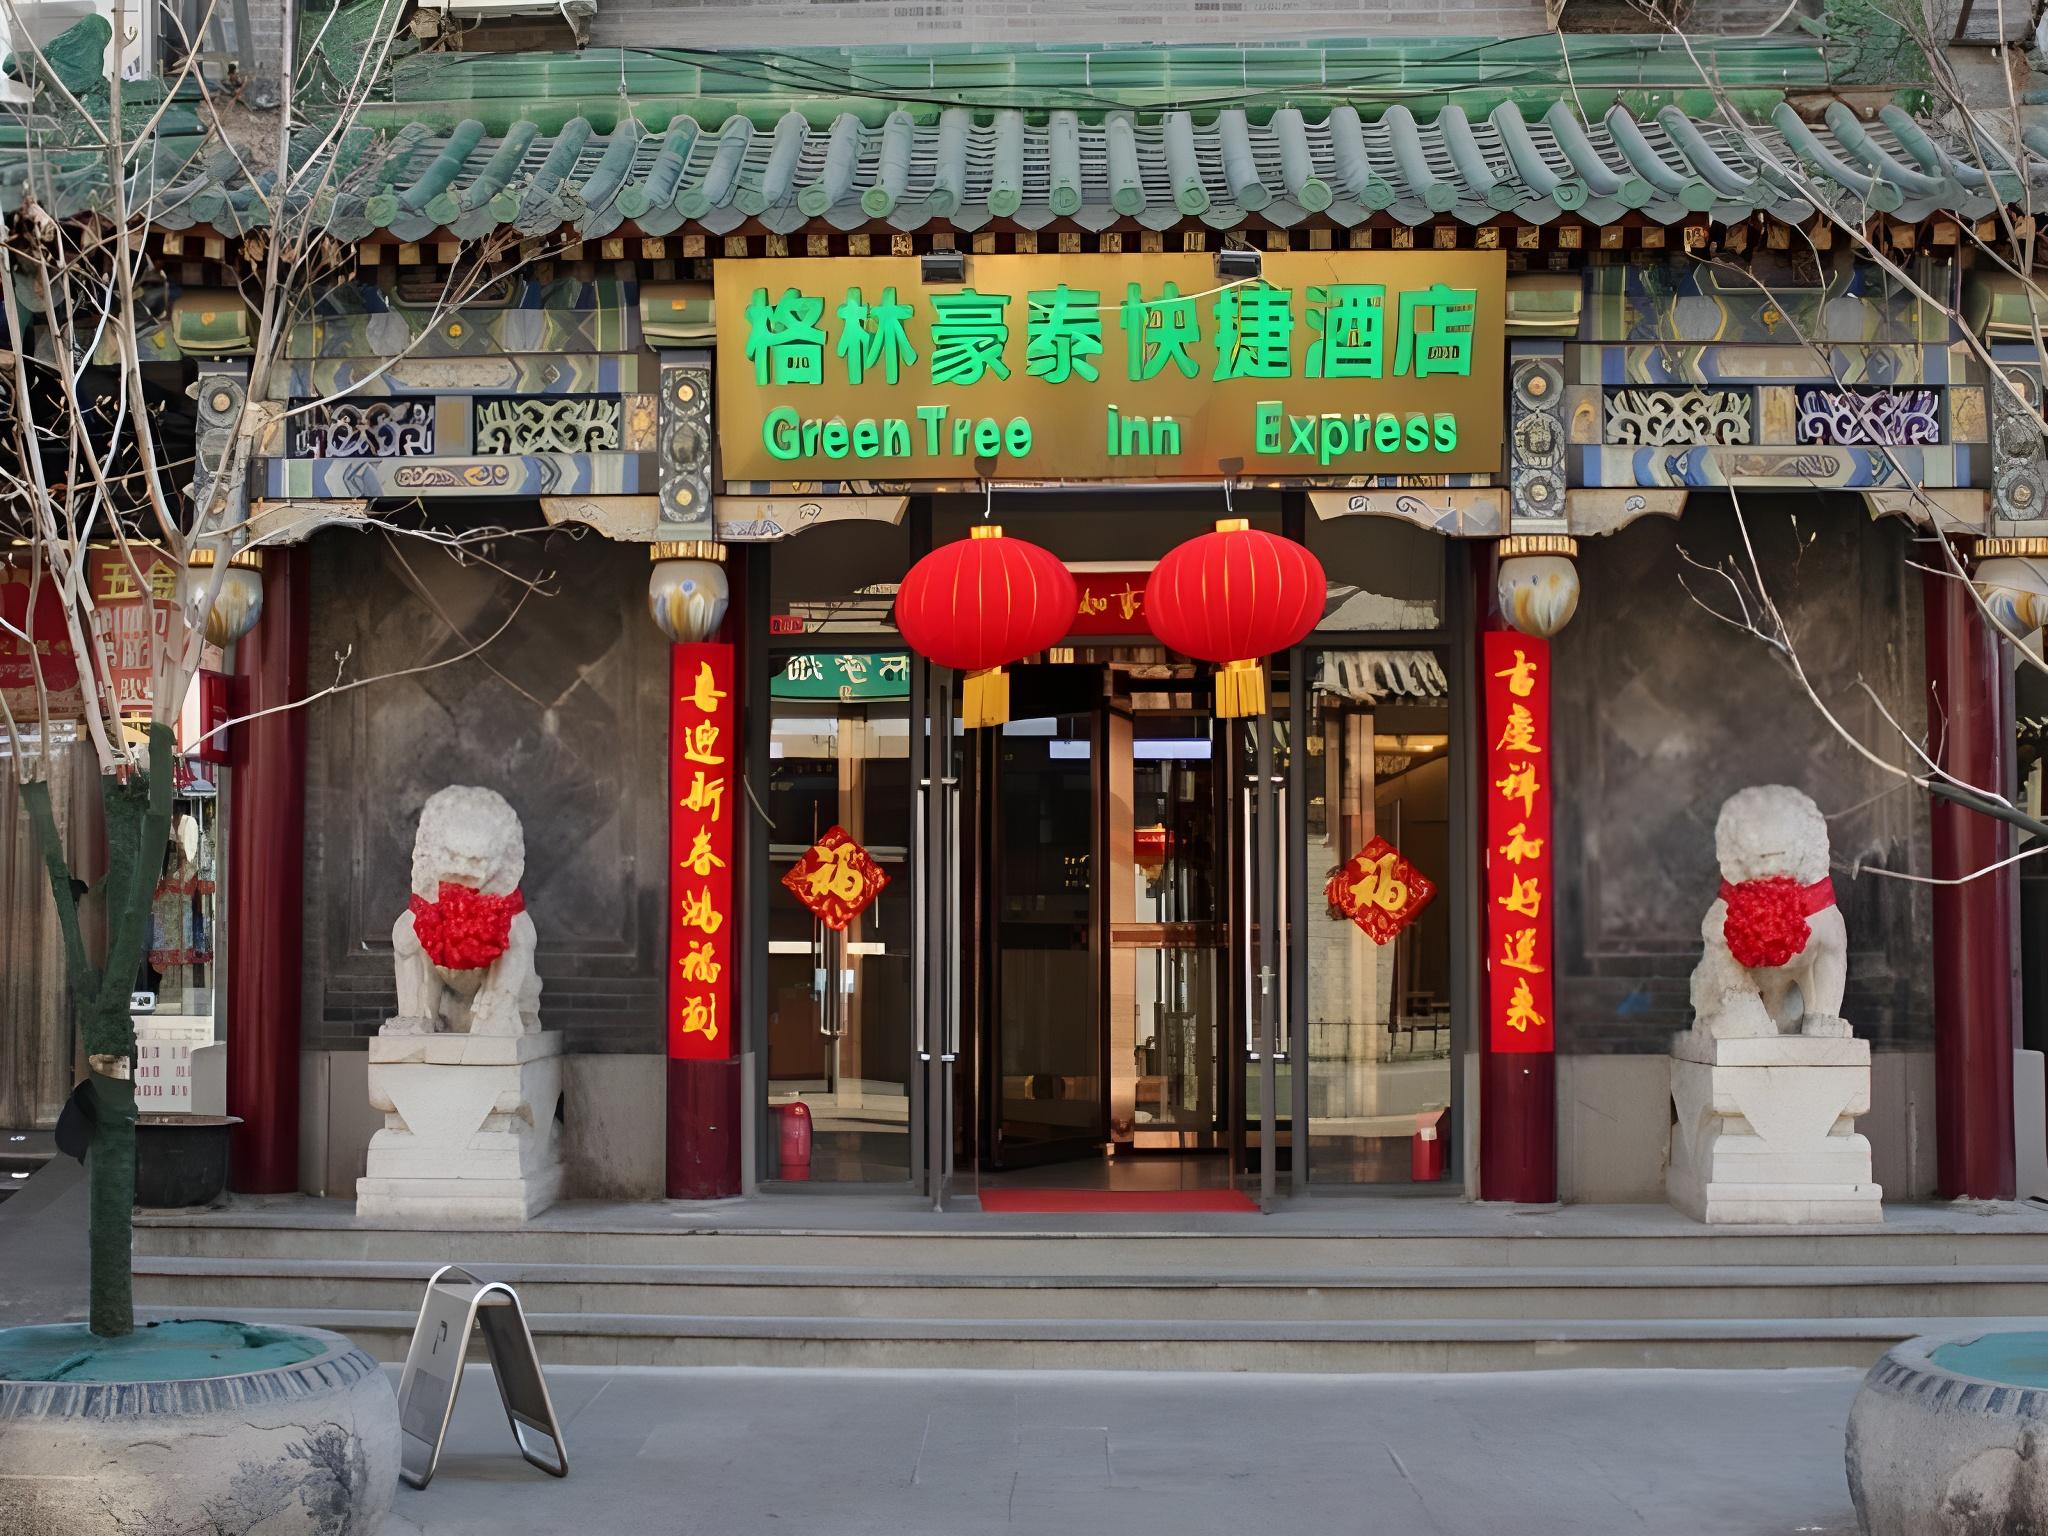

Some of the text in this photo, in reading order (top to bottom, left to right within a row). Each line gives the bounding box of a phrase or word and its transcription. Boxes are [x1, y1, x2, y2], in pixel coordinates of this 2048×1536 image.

[745, 282, 1477, 385] 格林豪泰快捷酒店
[1107, 403, 1181, 456] Inn
[1255, 400, 1458, 466] Express
[806, 842, 864, 902] 福
[1349, 852, 1408, 912] 福
